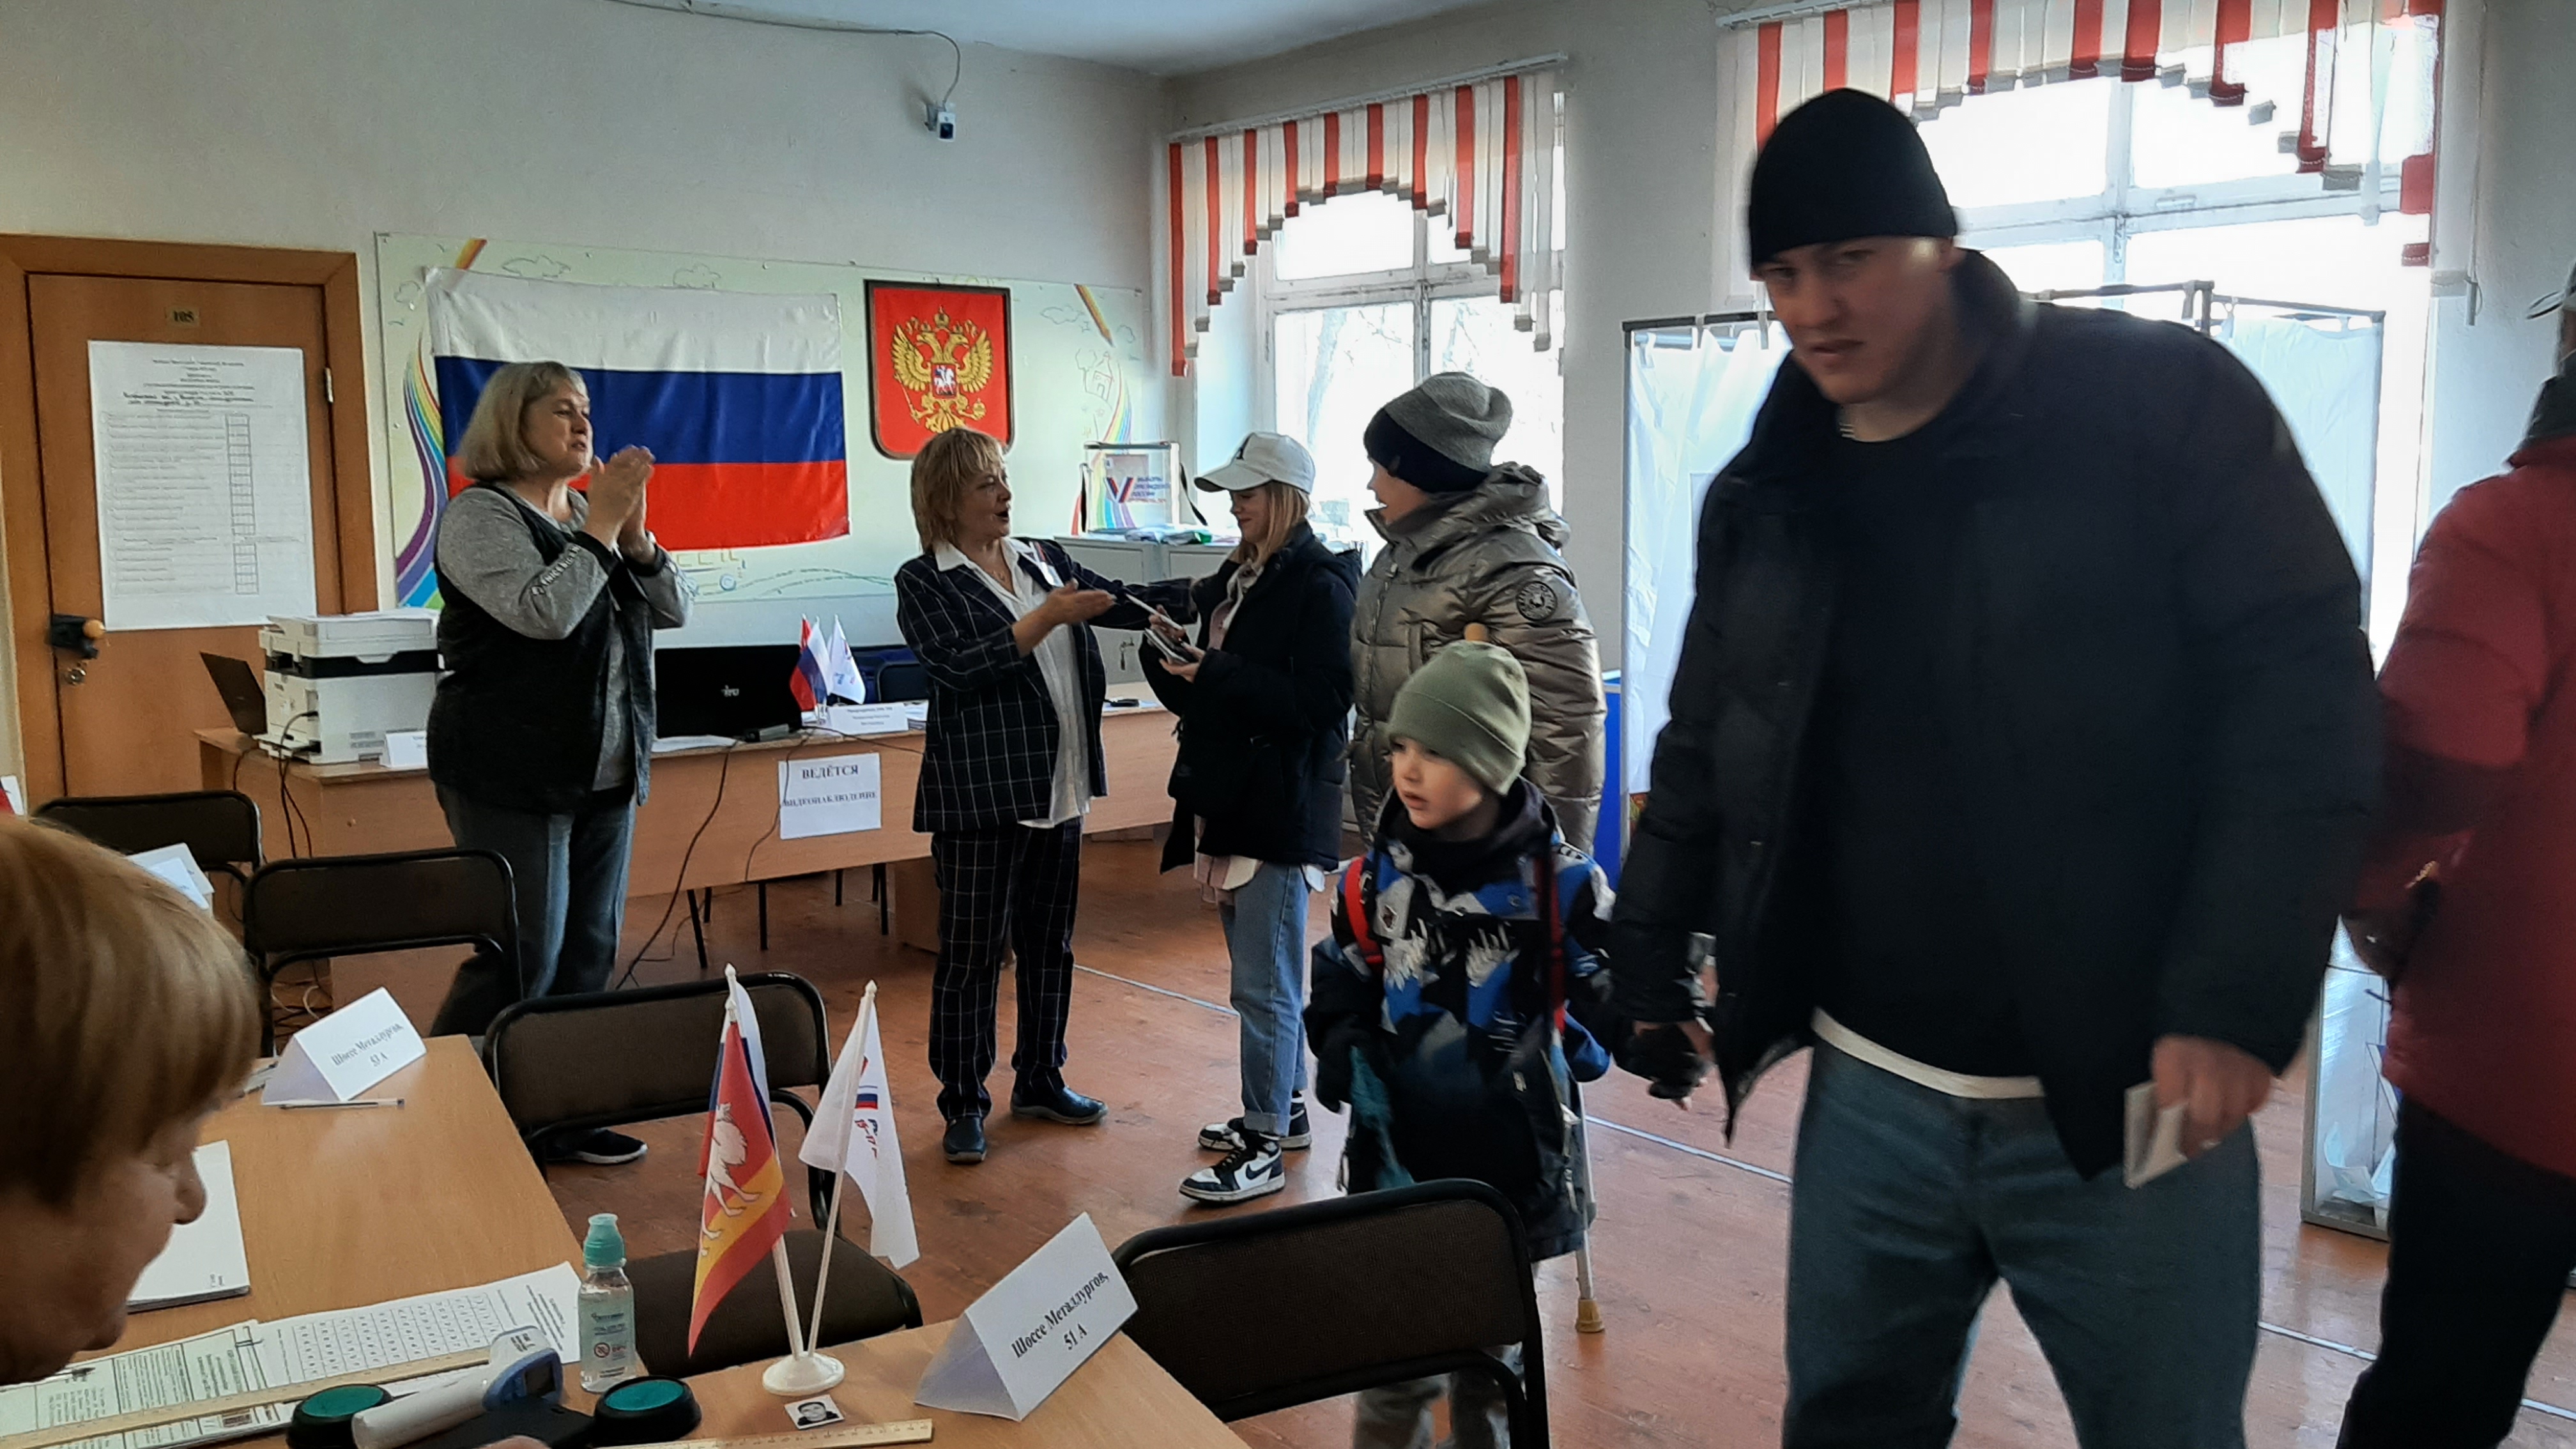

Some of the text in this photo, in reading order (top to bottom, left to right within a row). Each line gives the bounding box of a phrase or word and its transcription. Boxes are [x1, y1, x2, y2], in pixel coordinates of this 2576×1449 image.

[802, 764, 859, 779] ВЕДЁТСЯ
[1011, 1324, 1047, 1358] Шоссе
[1063, 1322, 1087, 1350] 51 А
